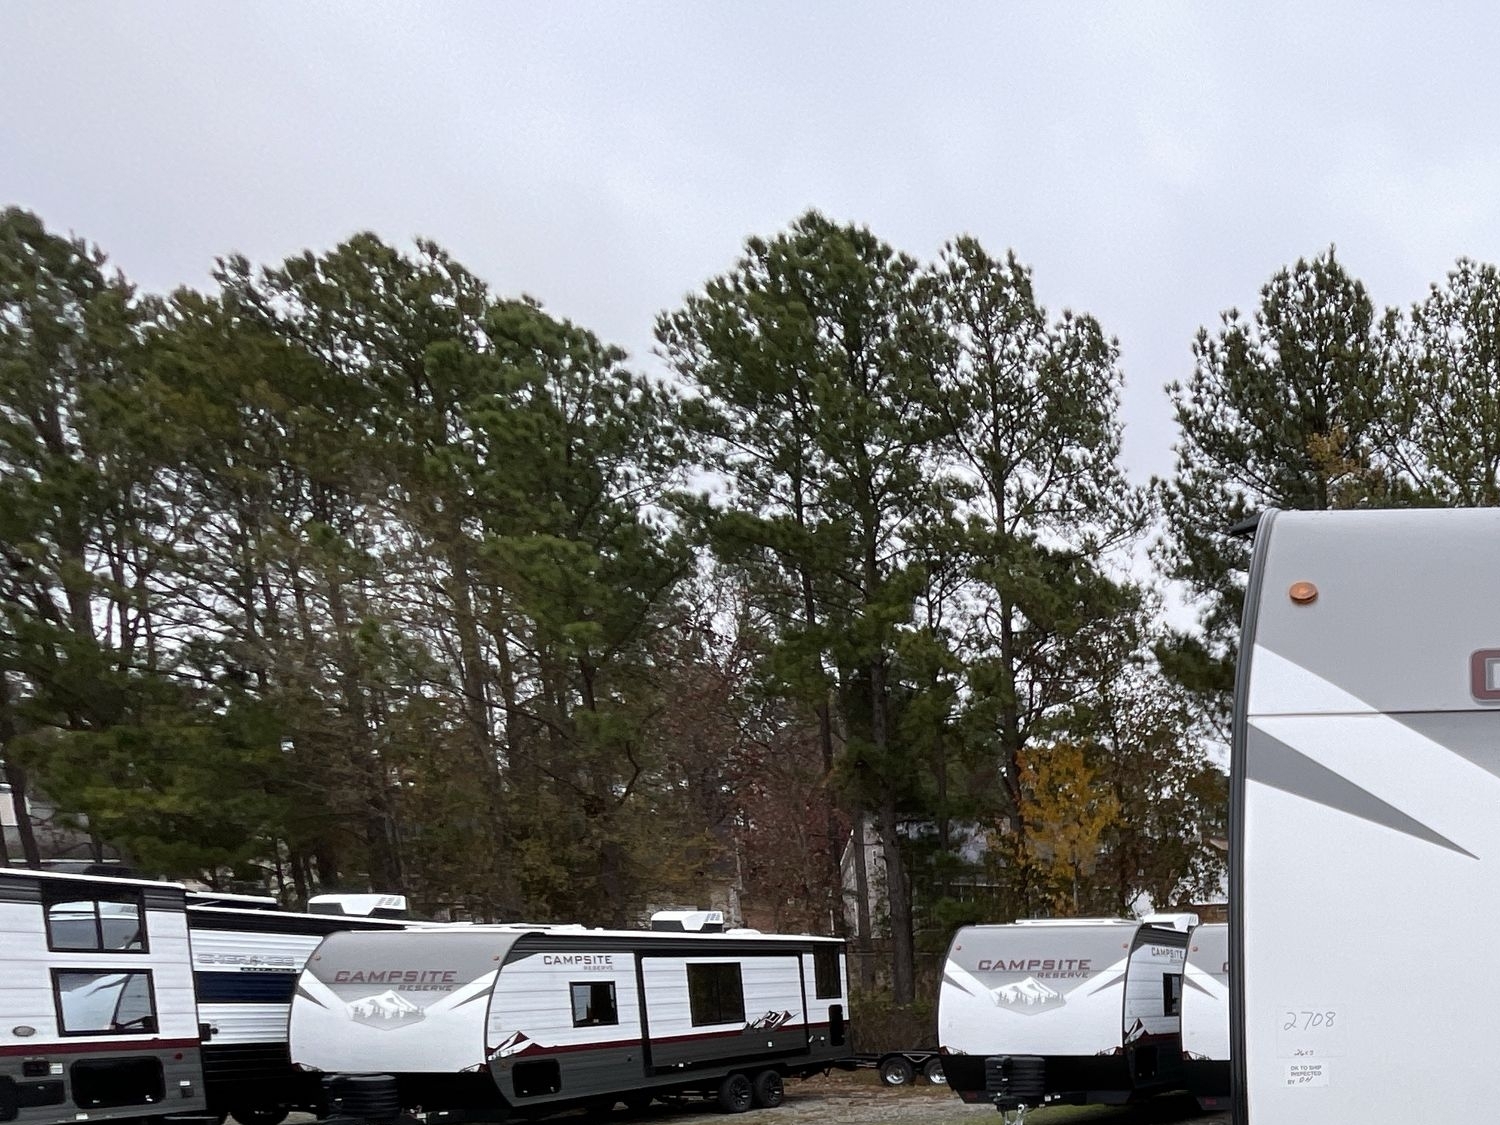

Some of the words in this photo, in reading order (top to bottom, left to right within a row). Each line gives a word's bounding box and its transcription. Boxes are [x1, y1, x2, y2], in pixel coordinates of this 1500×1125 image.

[1151, 946, 1184, 960] CAMPSITE
[543, 955, 613, 965] CAMPSITE
[977, 959, 1092, 971] CAMPSITE
[334, 970, 458, 983] CAMPSITE
[1037, 971, 1089, 979] RESERVE
[397, 984, 454, 992] RESERVE
[1283, 1011, 1337, 1032] 2708
